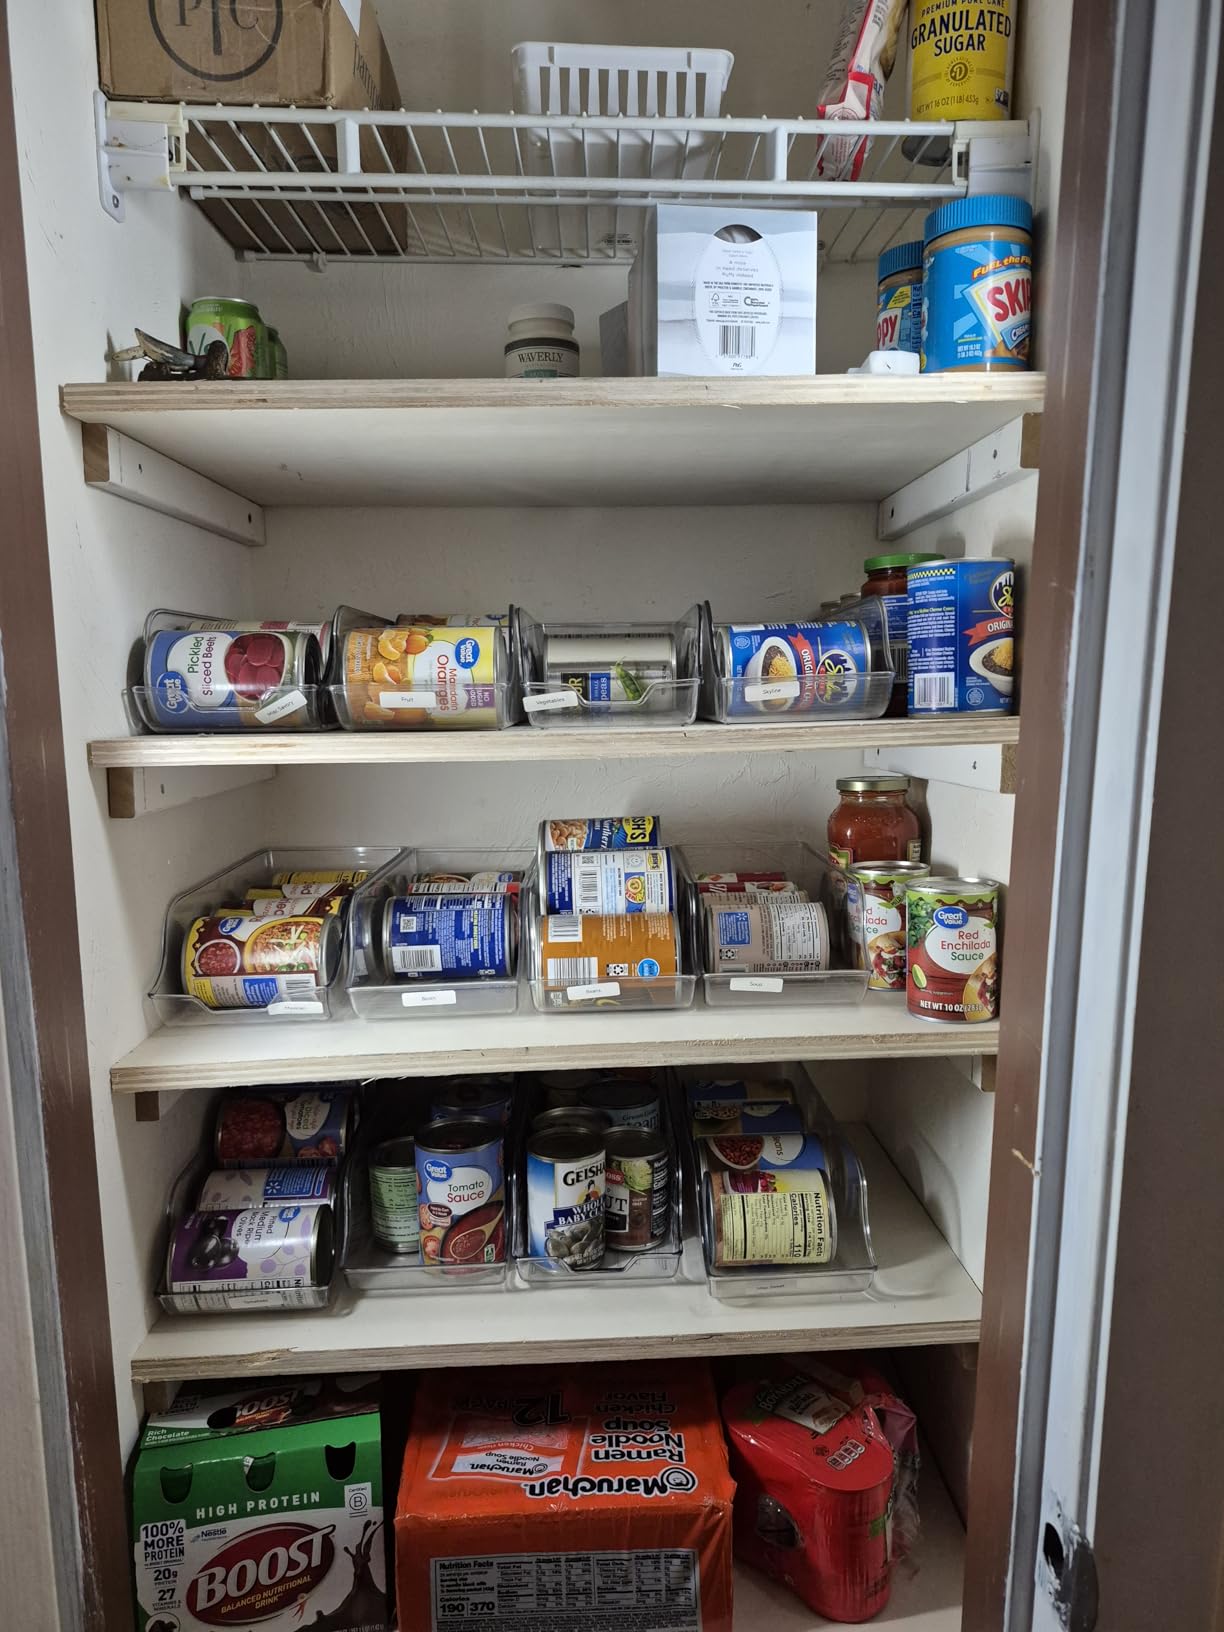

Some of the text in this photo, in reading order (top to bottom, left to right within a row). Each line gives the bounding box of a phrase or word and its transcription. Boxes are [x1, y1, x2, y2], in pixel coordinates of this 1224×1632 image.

[911, 10, 1011, 49] GRANULATED
[934, 34, 985, 57] SUGAR
[972, 263, 1003, 280] FUEL
[1004, 256, 1020, 266] the
[518, 351, 564, 364] WAVERLY
[188, 636, 204, 674] Pickled
[465, 638, 475, 664] Great
[202, 636, 216, 696] Sliced Beets
[436, 654, 449, 712] Oranges
[449, 668, 457, 711] Mandarin
[484, 691, 490, 702] NO
[938, 911, 963, 926] Great Value
[958, 930, 980, 941] Red
[940, 940, 991, 950] Enchilada
[950, 952, 984, 962] Sauce
[920, 1000, 931, 1009] NET
[932, 1001, 943, 1011] WT
[944, 1002, 954, 1011] 10
[954, 1004, 964, 1012] OZ
[426, 1163, 447, 1175] Great
[448, 1180, 484, 1192] Tomato
[447, 1190, 485, 1203] Sauce
[790, 1193, 799, 1226] Calories
[558, 1210, 586, 1226] BABY
[814, 1192, 825, 1257] Nutrition Facts
[236, 1216, 248, 1237] Olives
[236, 1392, 299, 1417] OOST
[606, 1392, 668, 1403] Flavor
[512, 1392, 570, 1426] 12
[594, 1404, 676, 1413] Chicken
[604, 1417, 670, 1432] Soup
[146, 1430, 190, 1442] Chocolate
[148, 1429, 167, 1437] Rich
[590, 1433, 682, 1448] Noodle
[594, 1449, 684, 1463] Ramen
[196, 1491, 321, 1520] HIGH PROTEIN
[142, 1521, 184, 1540] 100%
[144, 1536, 184, 1551] MORE
[144, 1547, 185, 1562] PROTEIN
[192, 1524, 336, 1612] BOOST
[439, 1562, 471, 1570] Nutrition
[154, 1568, 178, 1582] 20g
[158, 1588, 176, 1601] 27
[221, 1574, 312, 1614] BALANCED NUTRITIONAL
[254, 1597, 279, 1610] DRINK
[440, 1601, 495, 1613] 190 370
